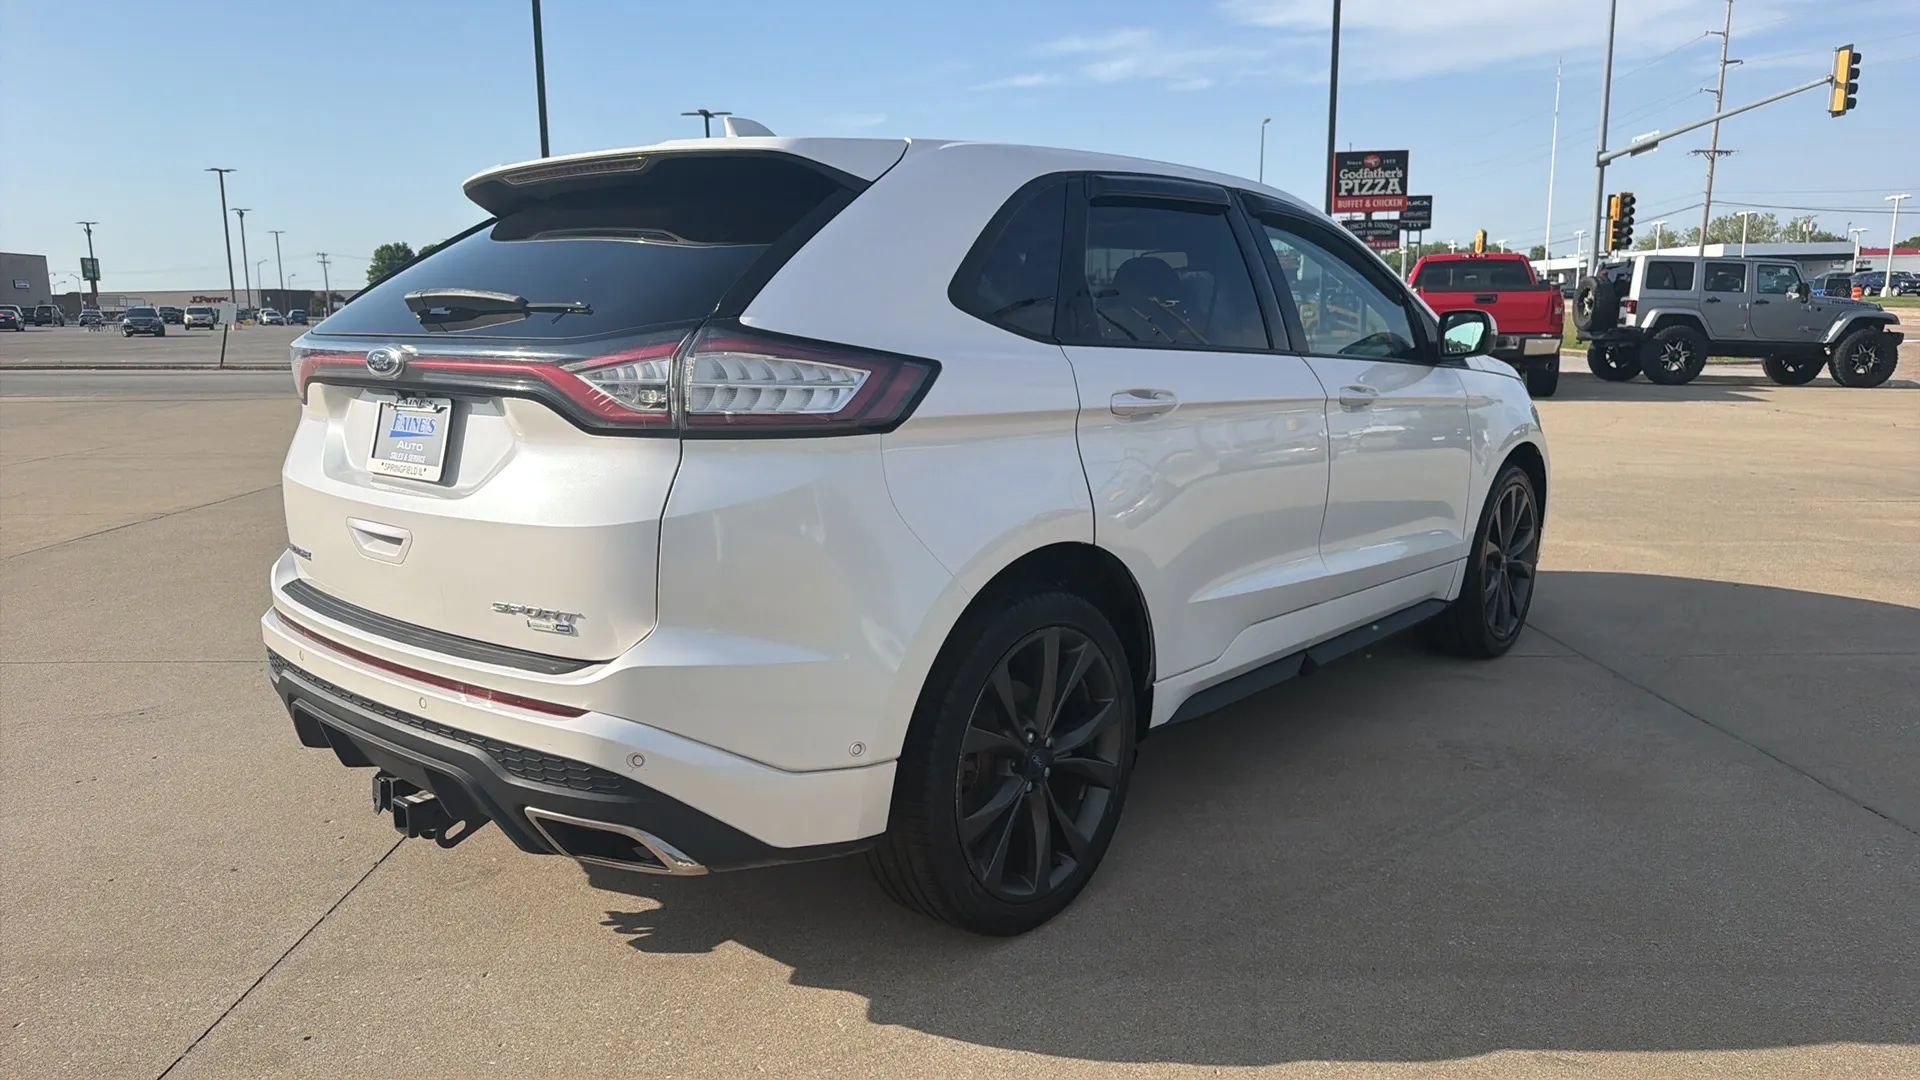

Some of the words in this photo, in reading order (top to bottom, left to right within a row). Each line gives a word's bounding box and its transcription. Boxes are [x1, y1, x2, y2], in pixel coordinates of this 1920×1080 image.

[1339, 168, 1402, 179] Godfather's
[1339, 178, 1402, 195] PIZZA
[1338, 199, 1363, 208] BUFFET
[1365, 199, 1371, 208] &
[1372, 198, 1403, 207] CHICKEN
[370, 353, 390, 369] Ford
[392, 413, 436, 433] FAINE'S
[396, 440, 423, 451] AUTO
[408, 454, 426, 463] SERVICE
[492, 602, 586, 624] SPORT
